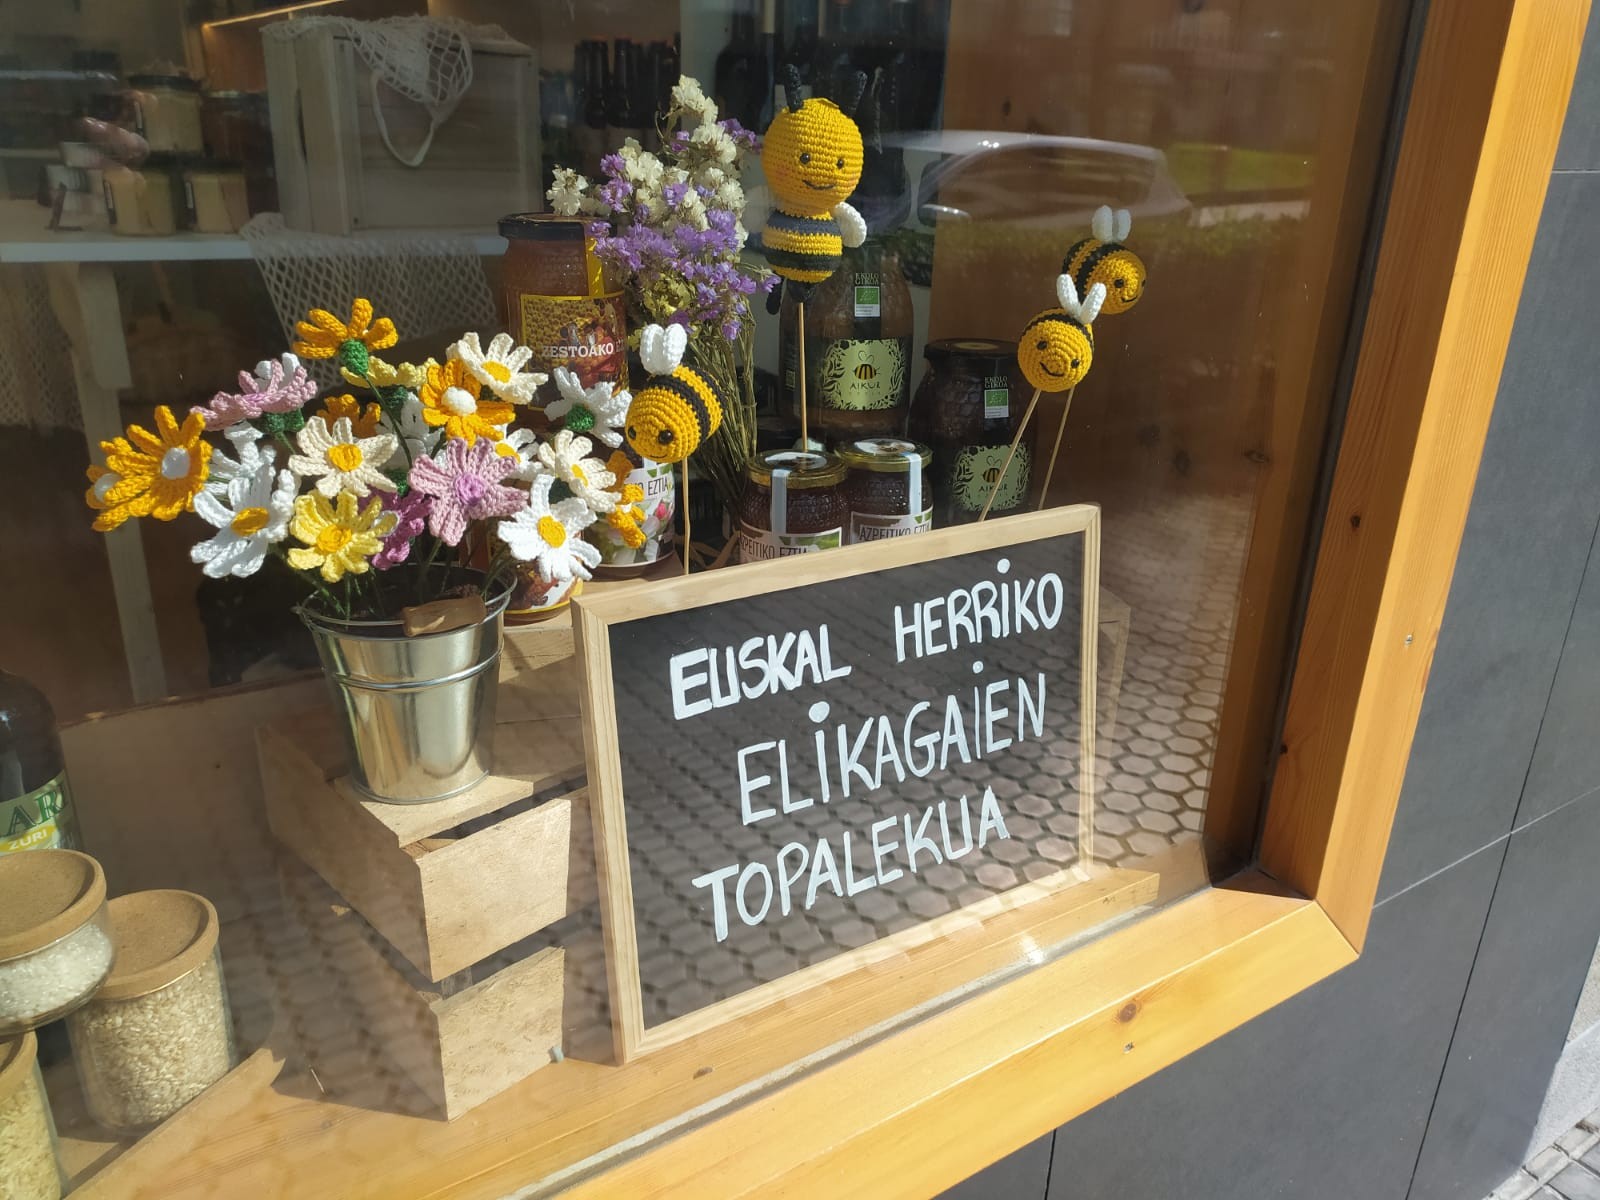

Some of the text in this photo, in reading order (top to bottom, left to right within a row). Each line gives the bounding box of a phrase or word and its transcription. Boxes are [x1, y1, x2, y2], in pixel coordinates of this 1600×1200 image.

[541, 342, 614, 358] ZESTOAKO
[669, 558, 1064, 721] EUSKAL HERRIKO
[737, 660, 1046, 826] ELIKAGAIEN
[8, 828, 48, 850] ZURI
[691, 785, 1011, 943] TOPALEKUA
